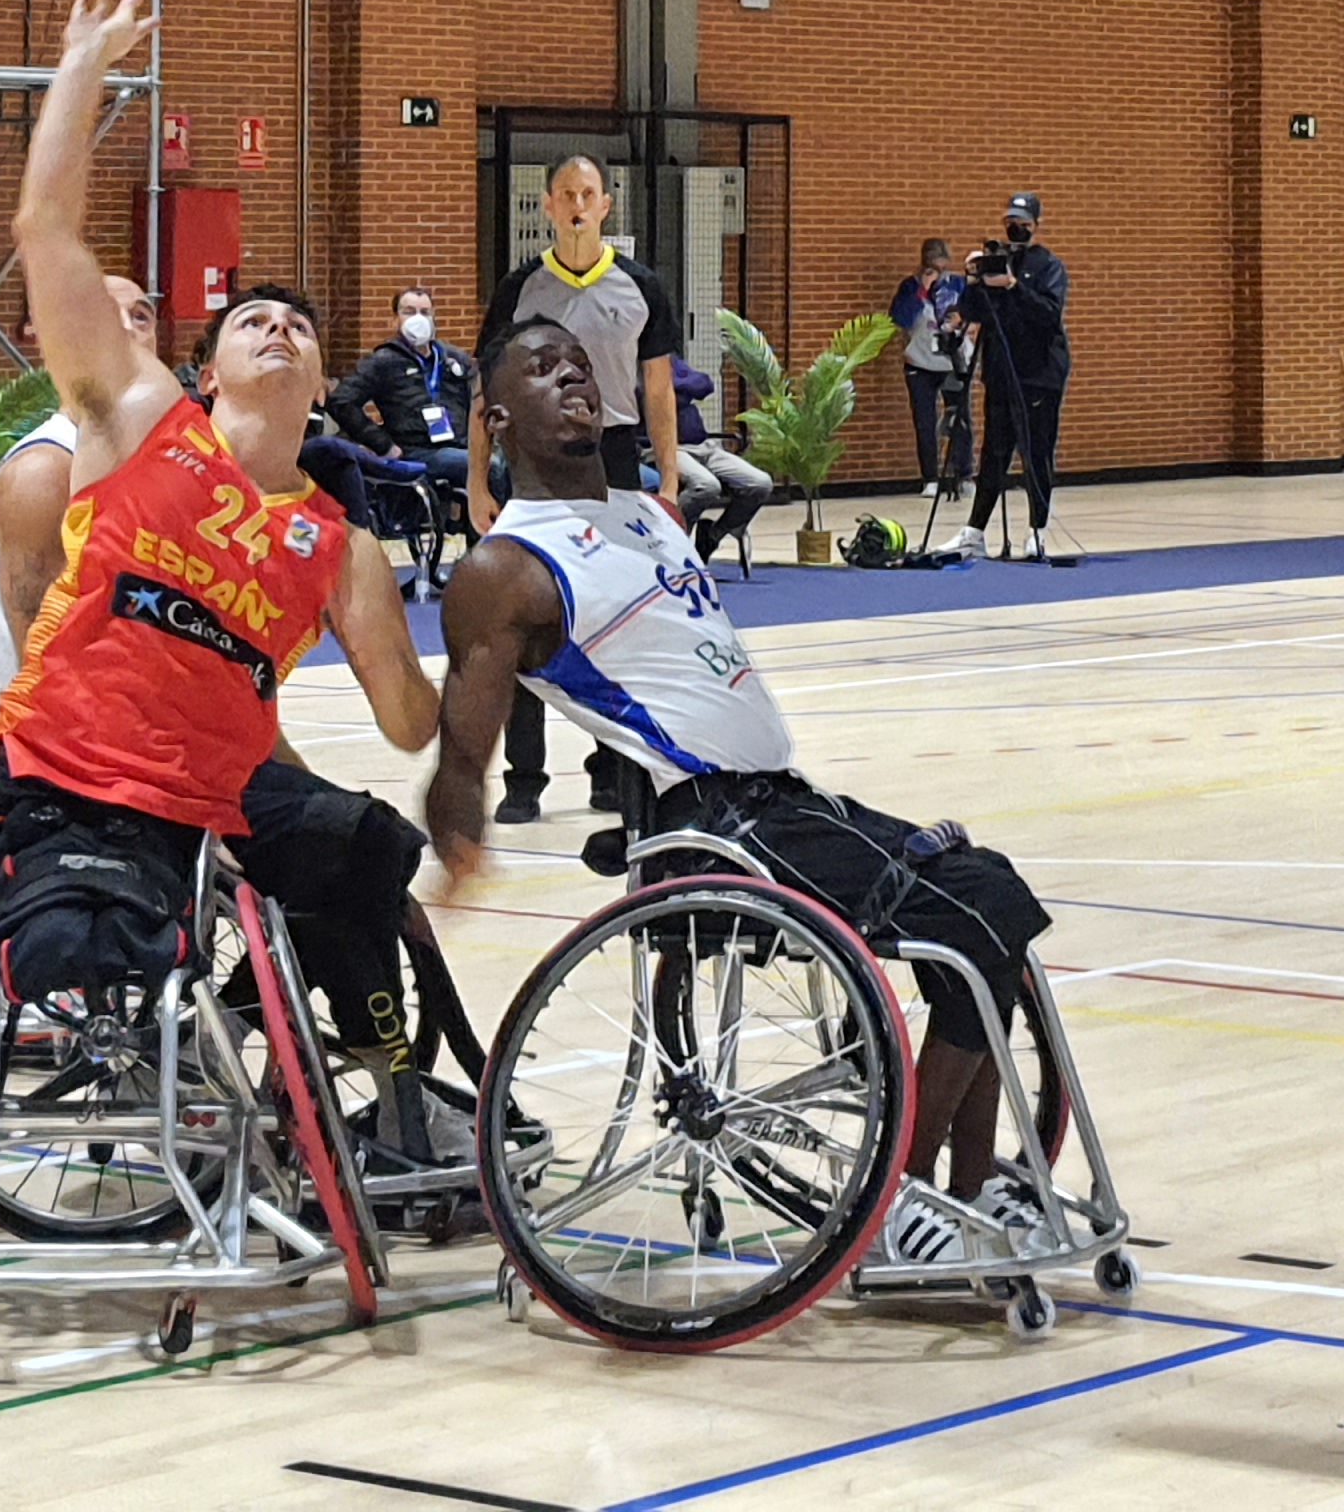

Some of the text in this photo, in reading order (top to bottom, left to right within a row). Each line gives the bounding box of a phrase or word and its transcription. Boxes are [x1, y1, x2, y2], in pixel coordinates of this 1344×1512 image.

[196, 484, 272, 566] 24
[132, 527, 285, 637] ESPAÑ
[367, 991, 412, 1073] NICO
